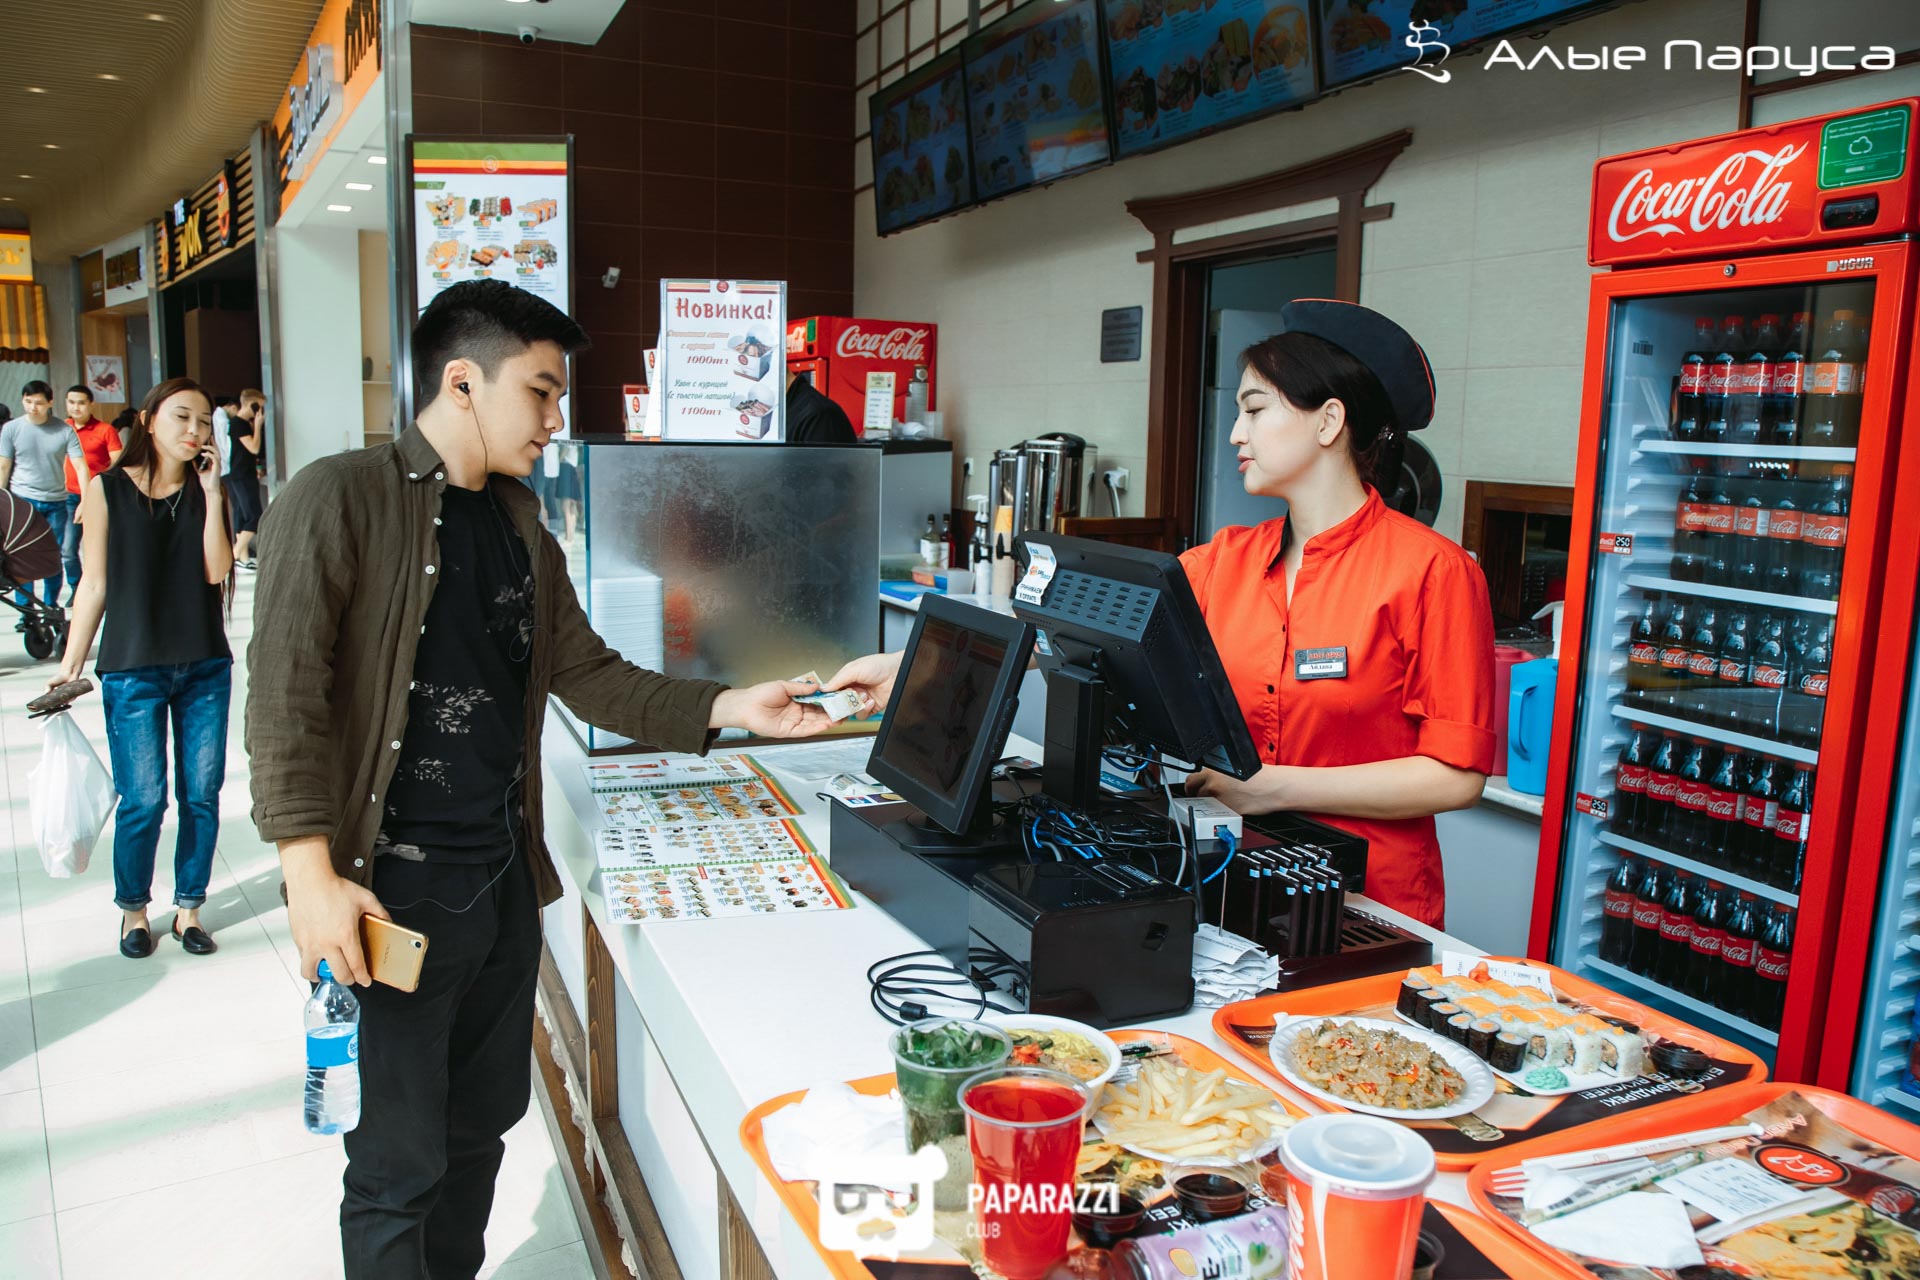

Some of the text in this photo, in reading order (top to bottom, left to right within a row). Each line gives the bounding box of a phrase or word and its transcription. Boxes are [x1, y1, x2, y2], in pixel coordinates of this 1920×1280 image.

[1608, 140, 1809, 243] Coca-Cola
[1838, 257, 1874, 271] UGUR
[676, 298, 773, 320] Новинка!
[836, 325, 929, 361] Coca-Cola
[1615, 536, 1630, 547] 250
[1592, 799, 1606, 811] 250
